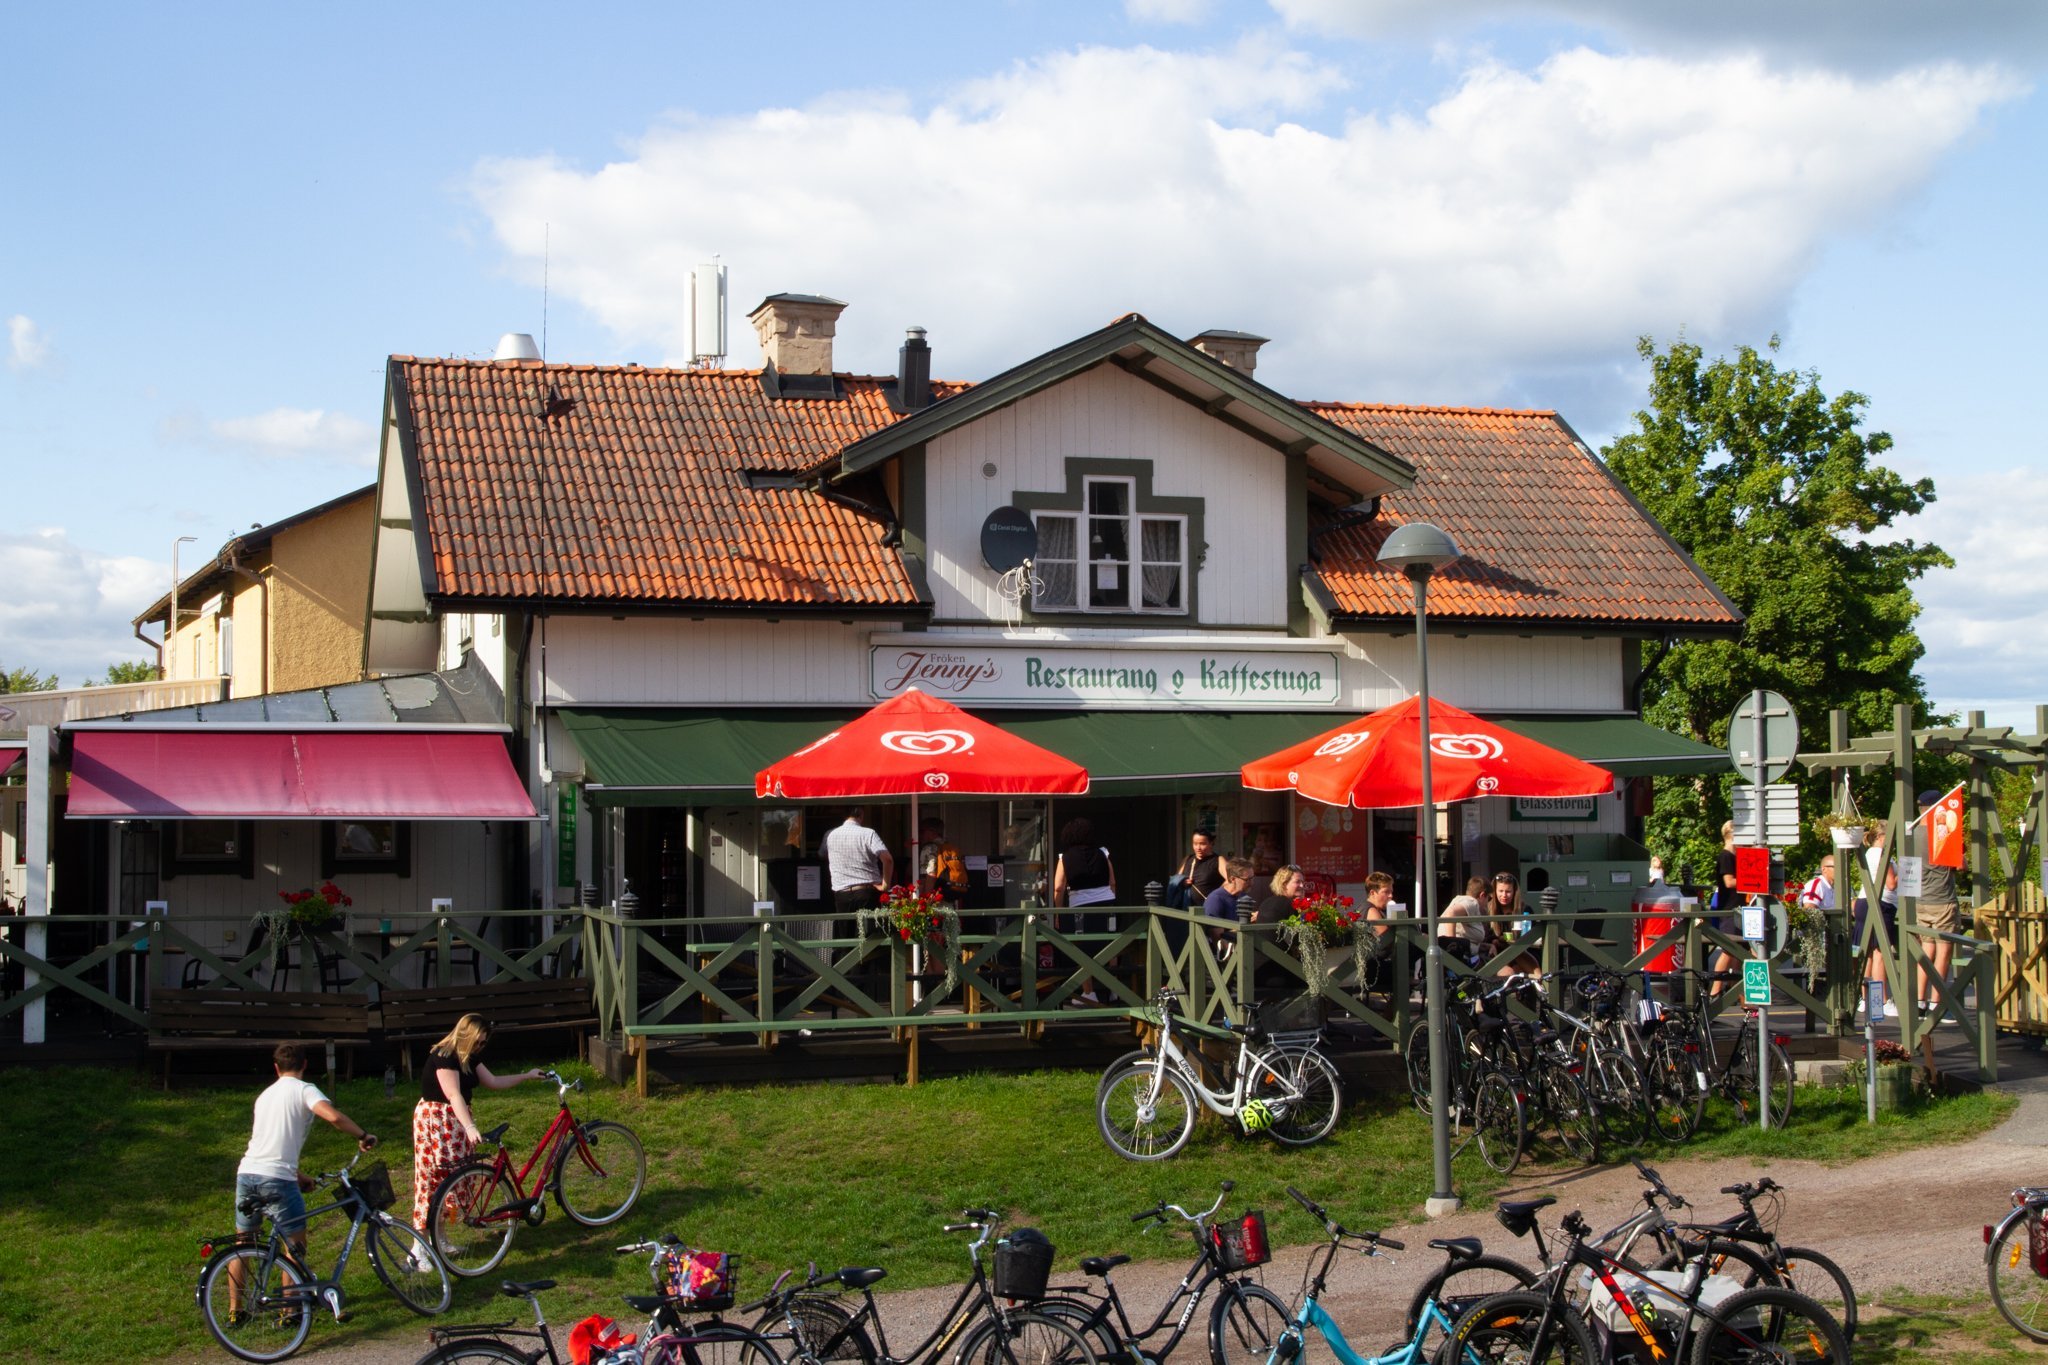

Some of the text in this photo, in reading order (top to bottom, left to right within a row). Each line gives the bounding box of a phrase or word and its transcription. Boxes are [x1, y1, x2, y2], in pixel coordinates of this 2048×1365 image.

[884, 651, 1003, 693] Jenny's
[930, 653, 966, 663] Fröken
[1025, 657, 1158, 694] Restaurang
[1200, 658, 1323, 697] Kaffestuga
[1179, 1059, 1199, 1084] Lifebike
[936, 1311, 970, 1351] MONARK
[1457, 1308, 1487, 1341] MAXXIS
[1602, 1265, 1667, 1360] TREK
